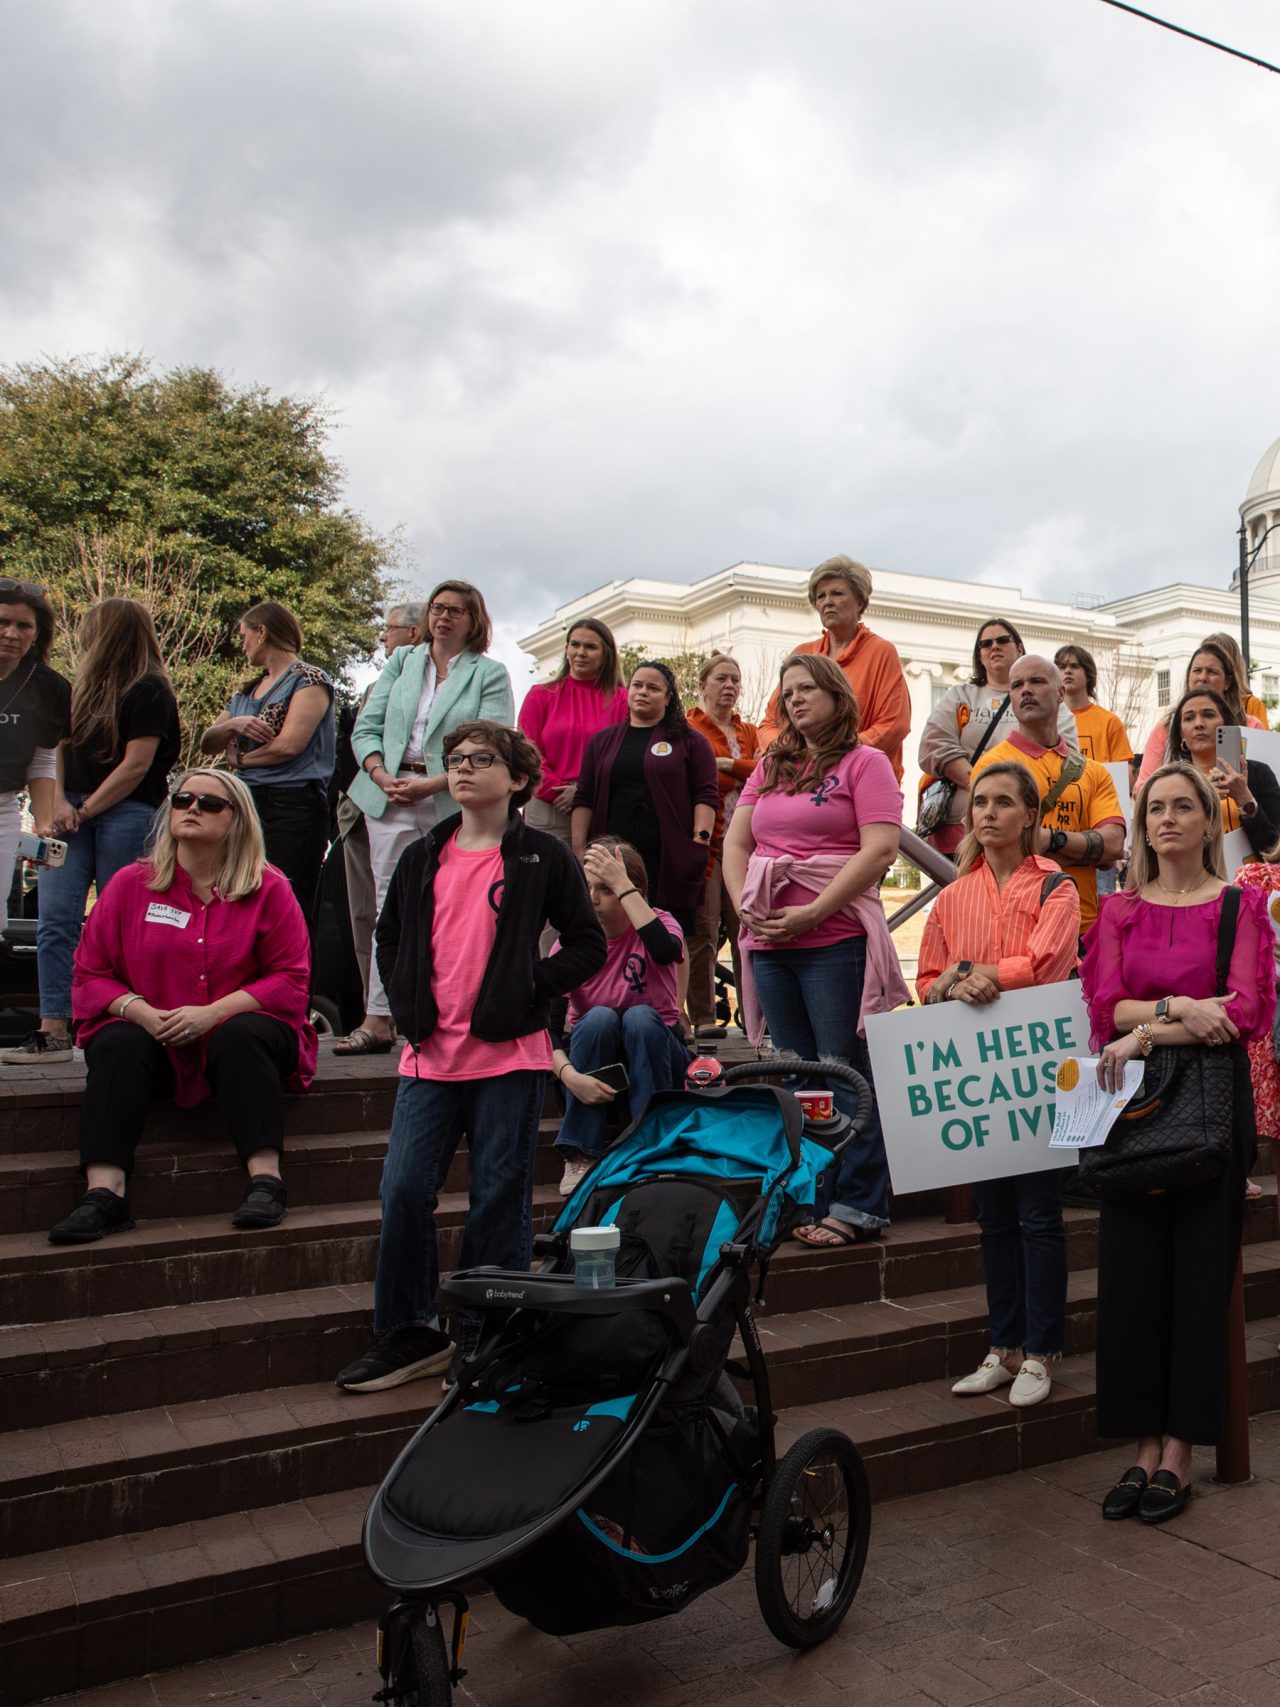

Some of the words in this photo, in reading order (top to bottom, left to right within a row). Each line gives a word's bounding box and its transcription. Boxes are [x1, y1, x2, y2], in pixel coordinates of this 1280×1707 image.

[904, 1037, 962, 1075] I'M
[976, 1016, 1077, 1064] HERE
[907, 1061, 1057, 1117] BECAUS
[941, 1114, 991, 1151] OF
